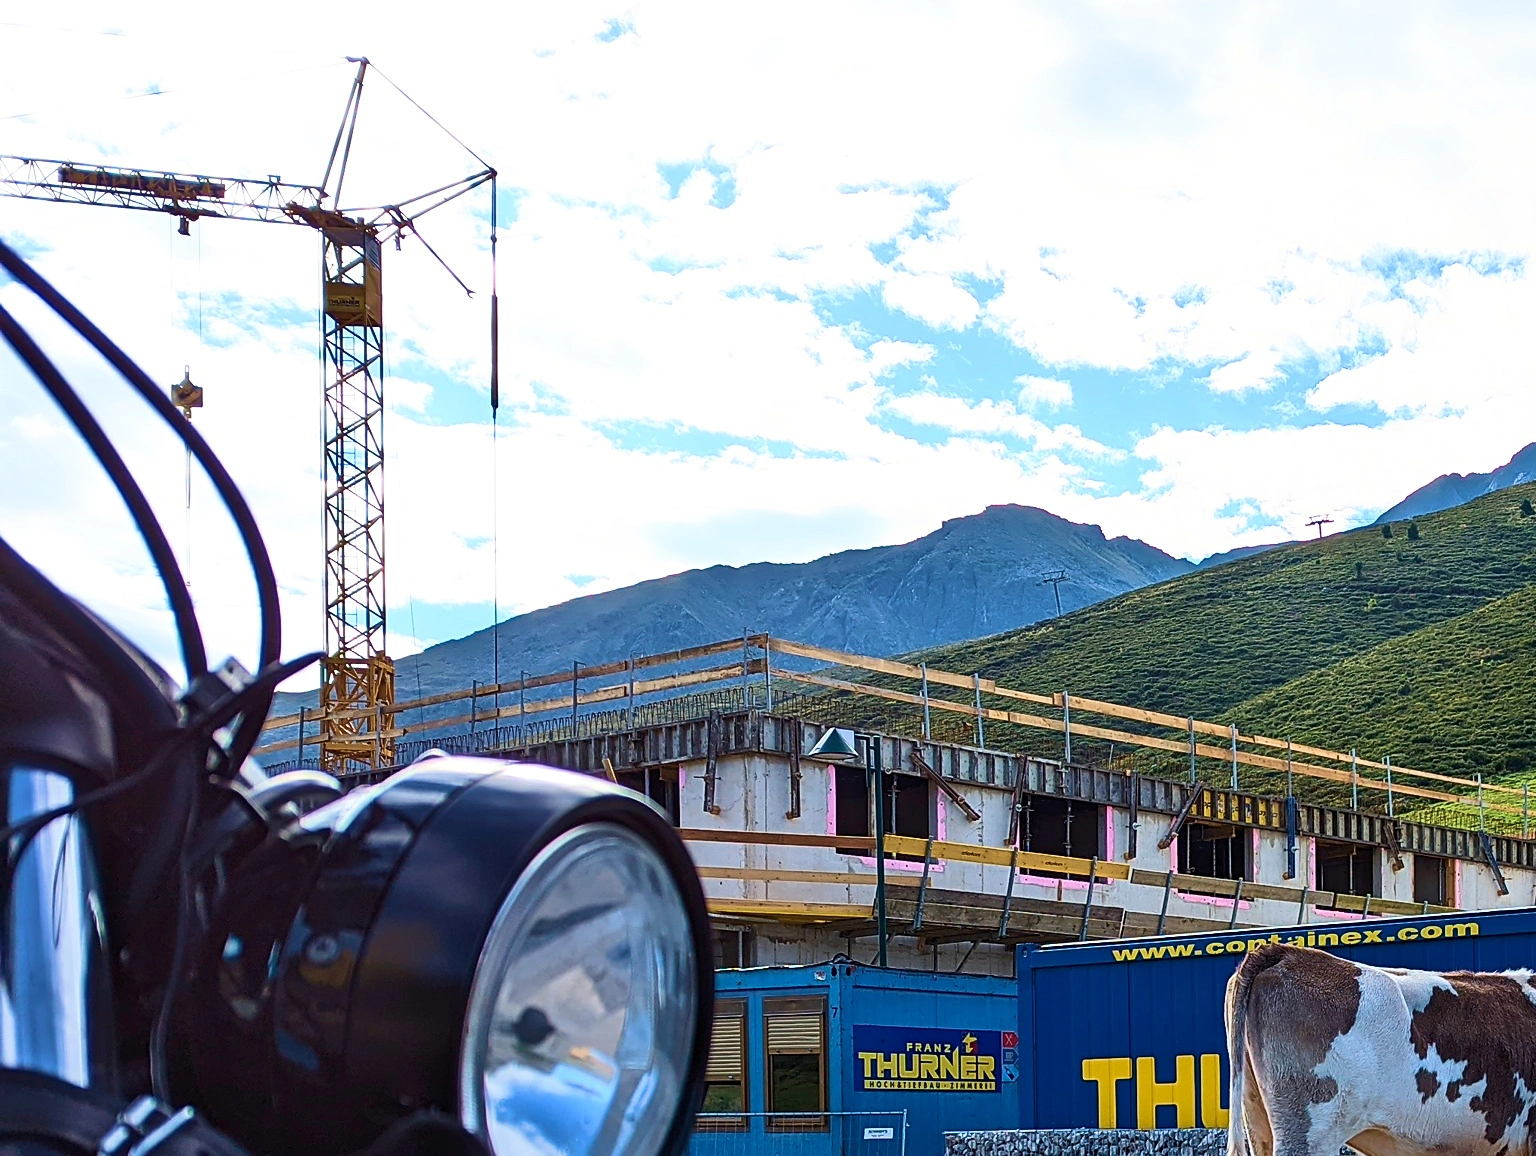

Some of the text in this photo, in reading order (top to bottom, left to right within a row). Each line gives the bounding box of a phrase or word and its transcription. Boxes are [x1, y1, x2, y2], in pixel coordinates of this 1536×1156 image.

[831, 1006, 839, 1019] 7
[906, 1042, 951, 1053] FRANZ
[858, 1046, 996, 1080] THURNER
[950, 1082, 993, 1090] ZIMMEREI
